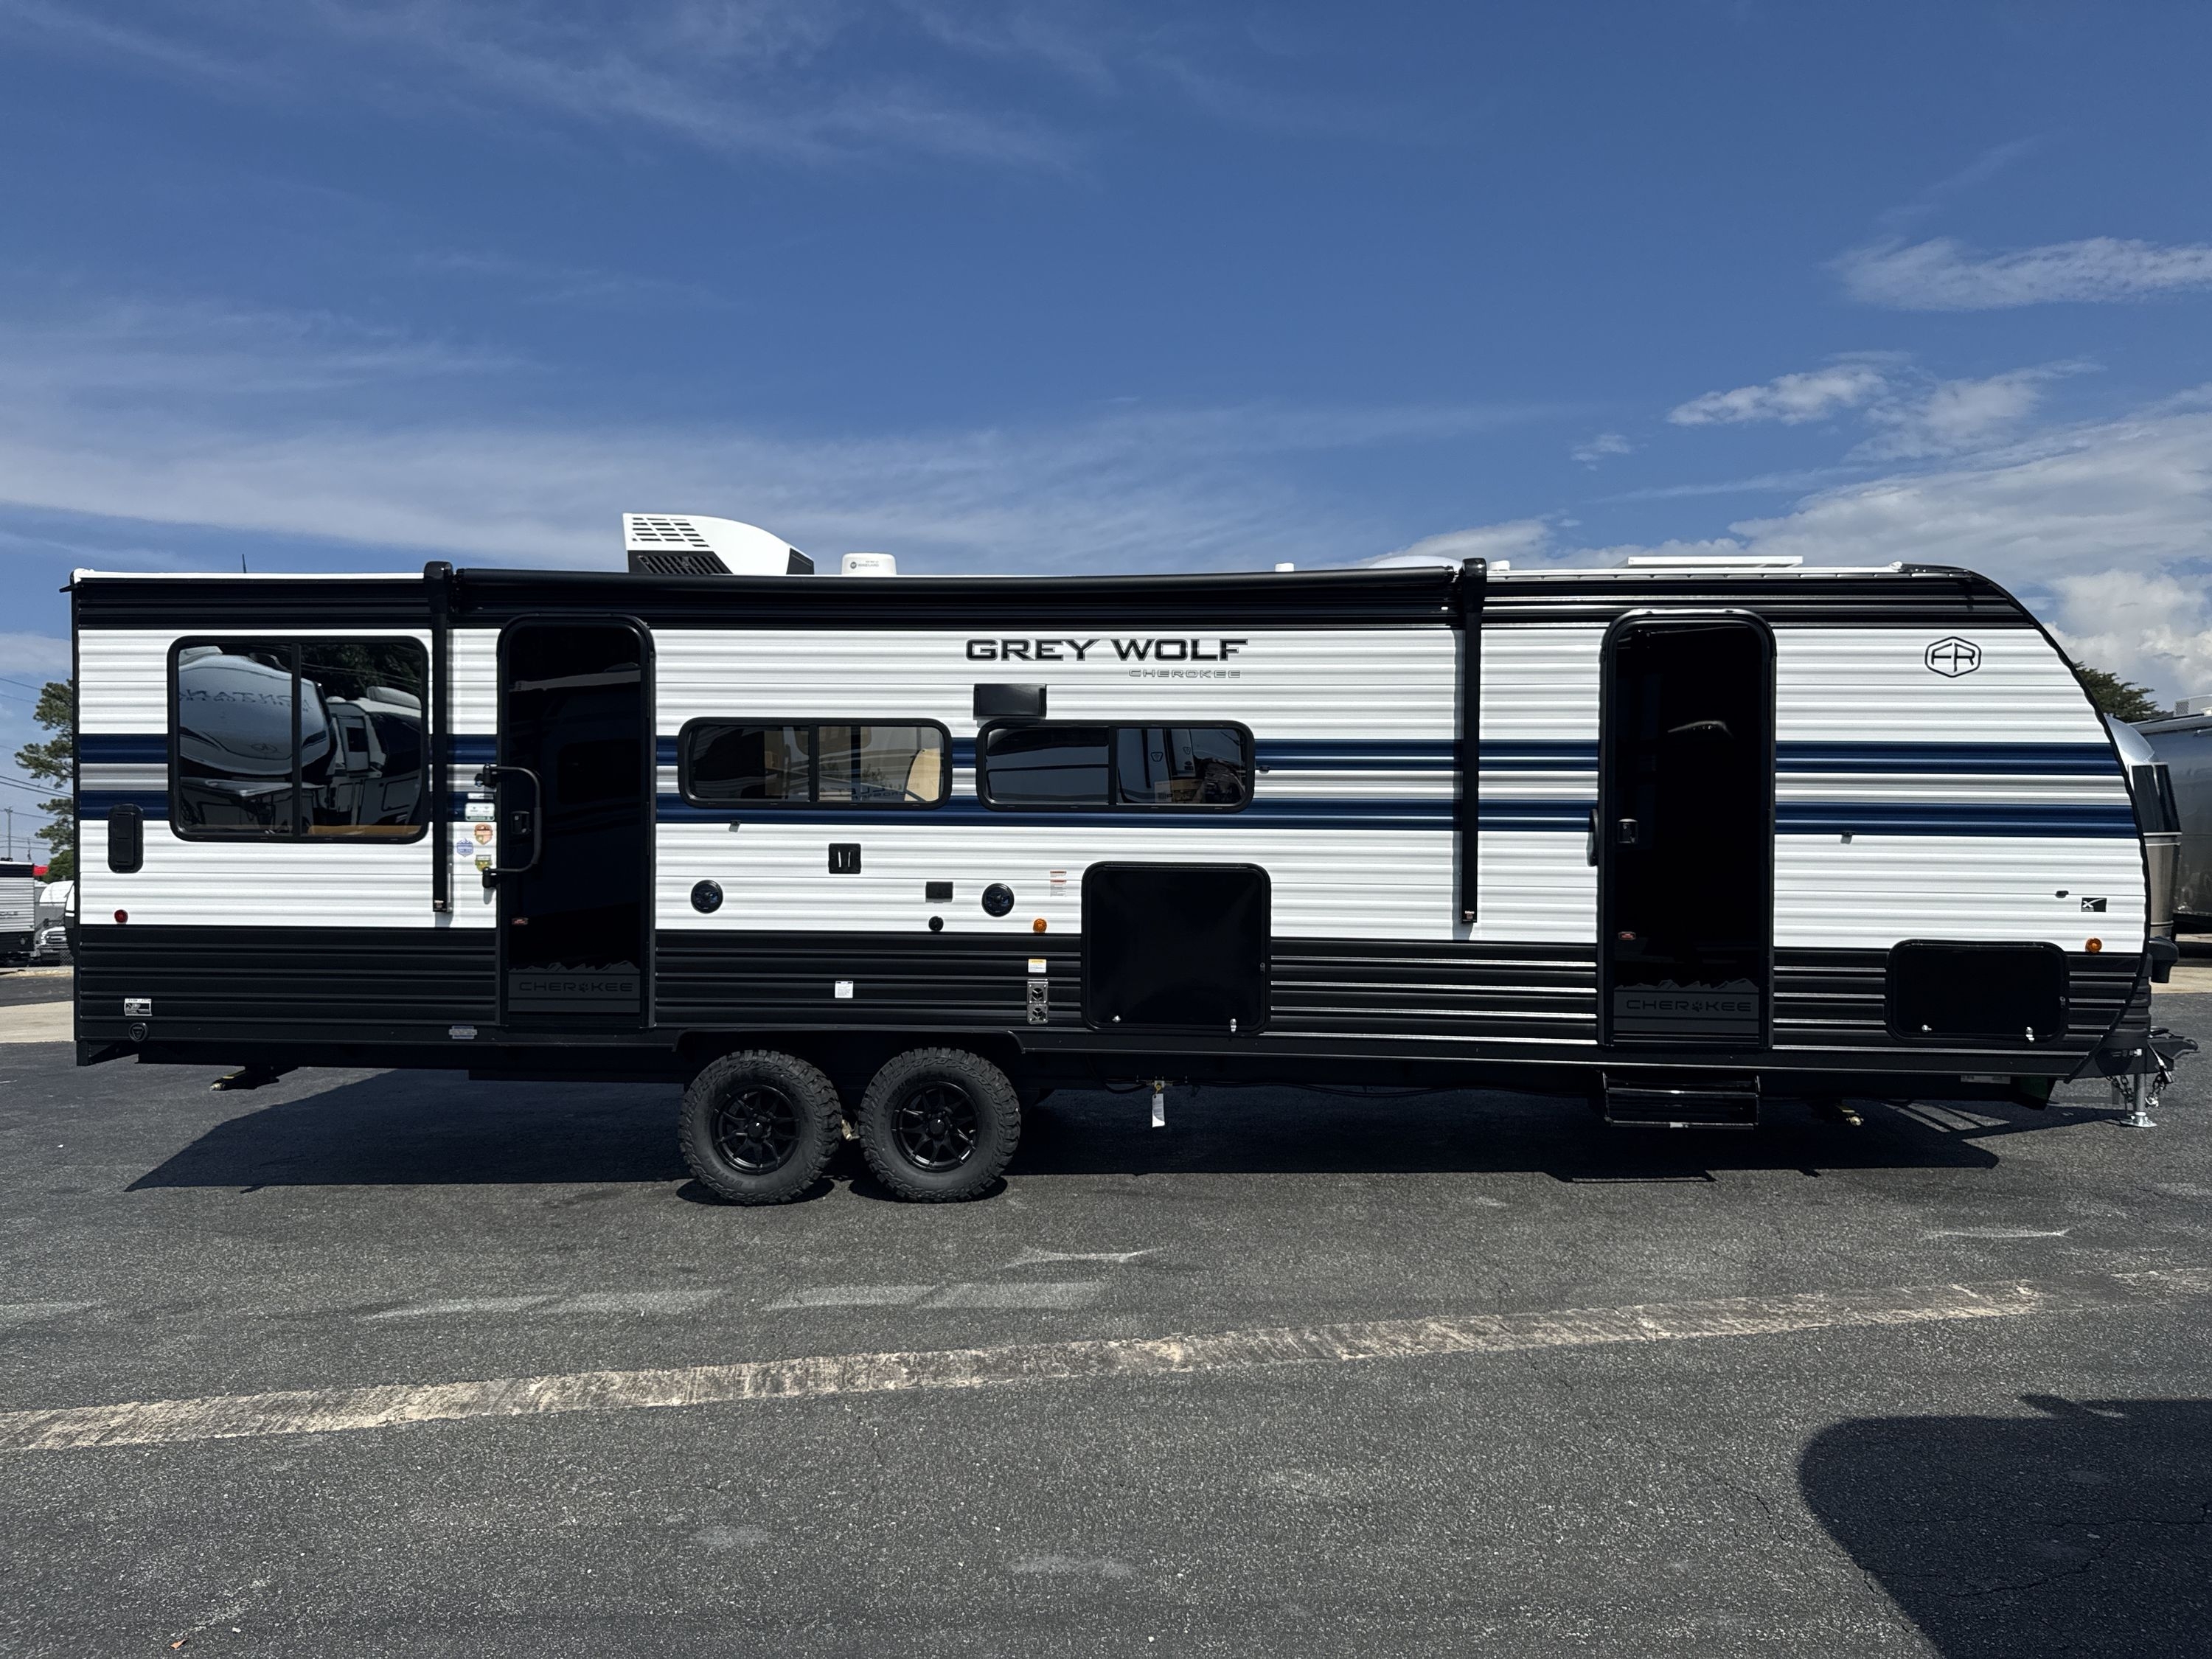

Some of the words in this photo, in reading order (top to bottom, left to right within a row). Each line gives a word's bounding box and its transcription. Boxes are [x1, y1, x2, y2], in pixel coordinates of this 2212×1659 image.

[965, 639, 1101, 661] GREY
[1110, 639, 1248, 661] WOLF
[1930, 642, 1976, 672] FR
[1128, 669, 1241, 678] CHEROKEE
